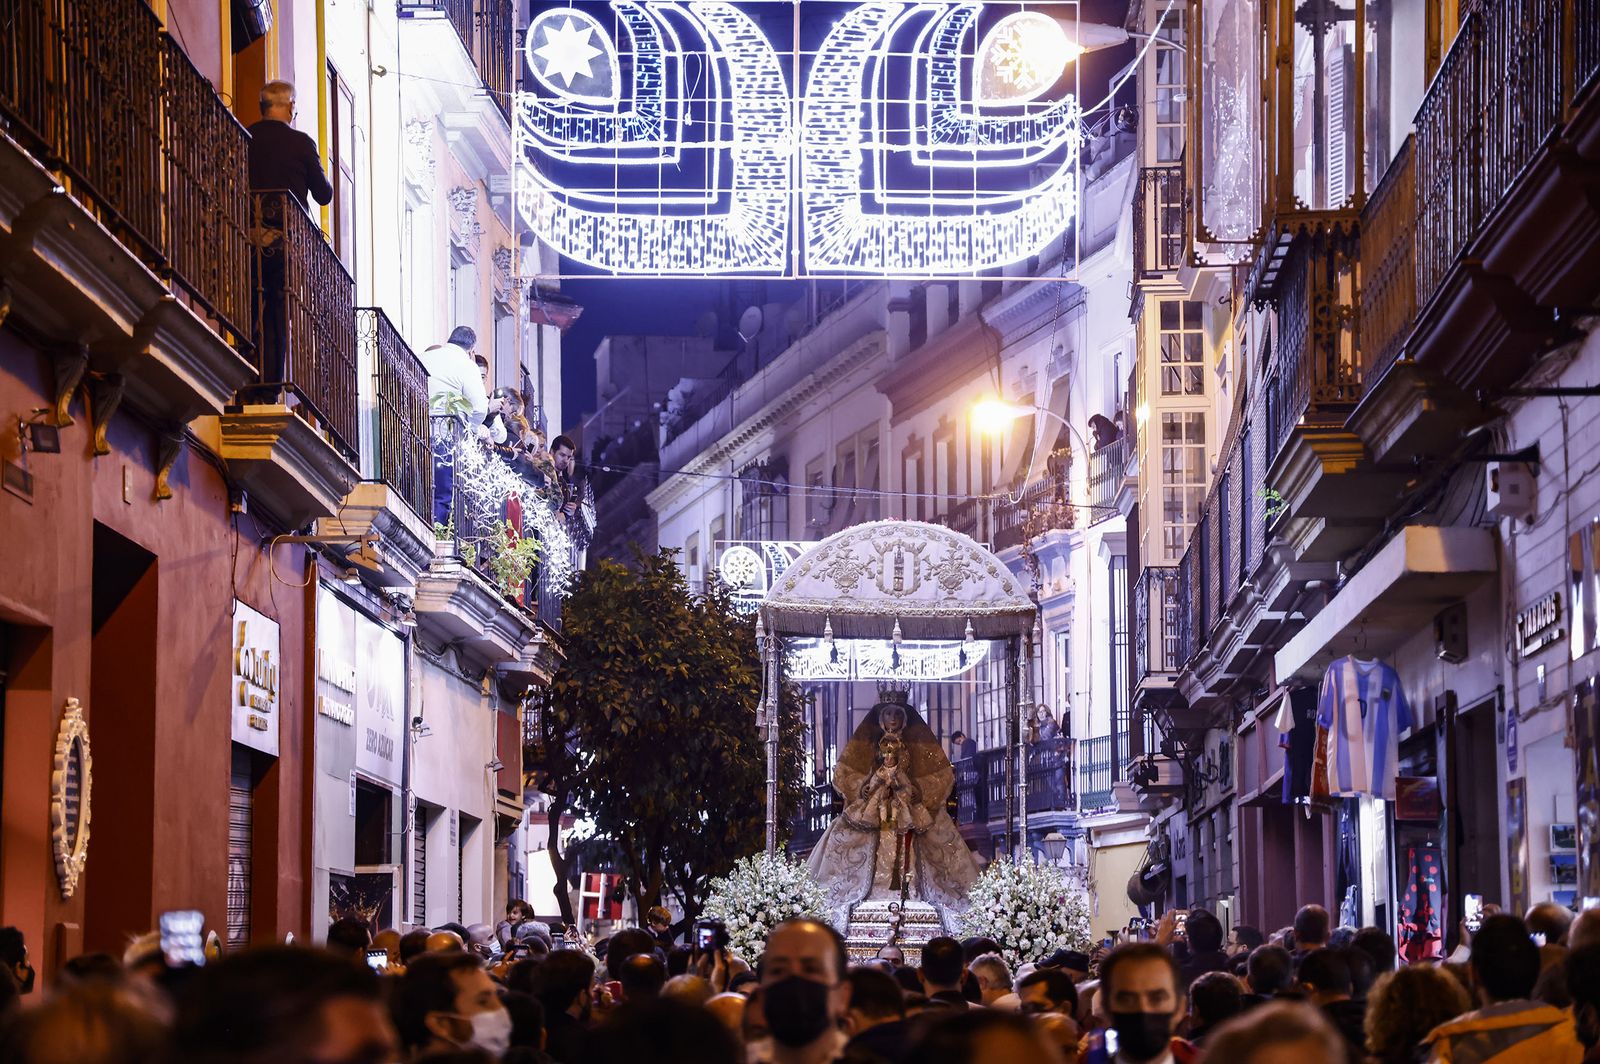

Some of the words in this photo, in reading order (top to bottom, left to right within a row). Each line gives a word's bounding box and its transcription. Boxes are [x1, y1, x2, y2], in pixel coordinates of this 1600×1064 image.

[1523, 593, 1557, 639] TABACOS
[366, 727, 377, 753] ZERO
[378, 728, 394, 762] AZÚCAR
